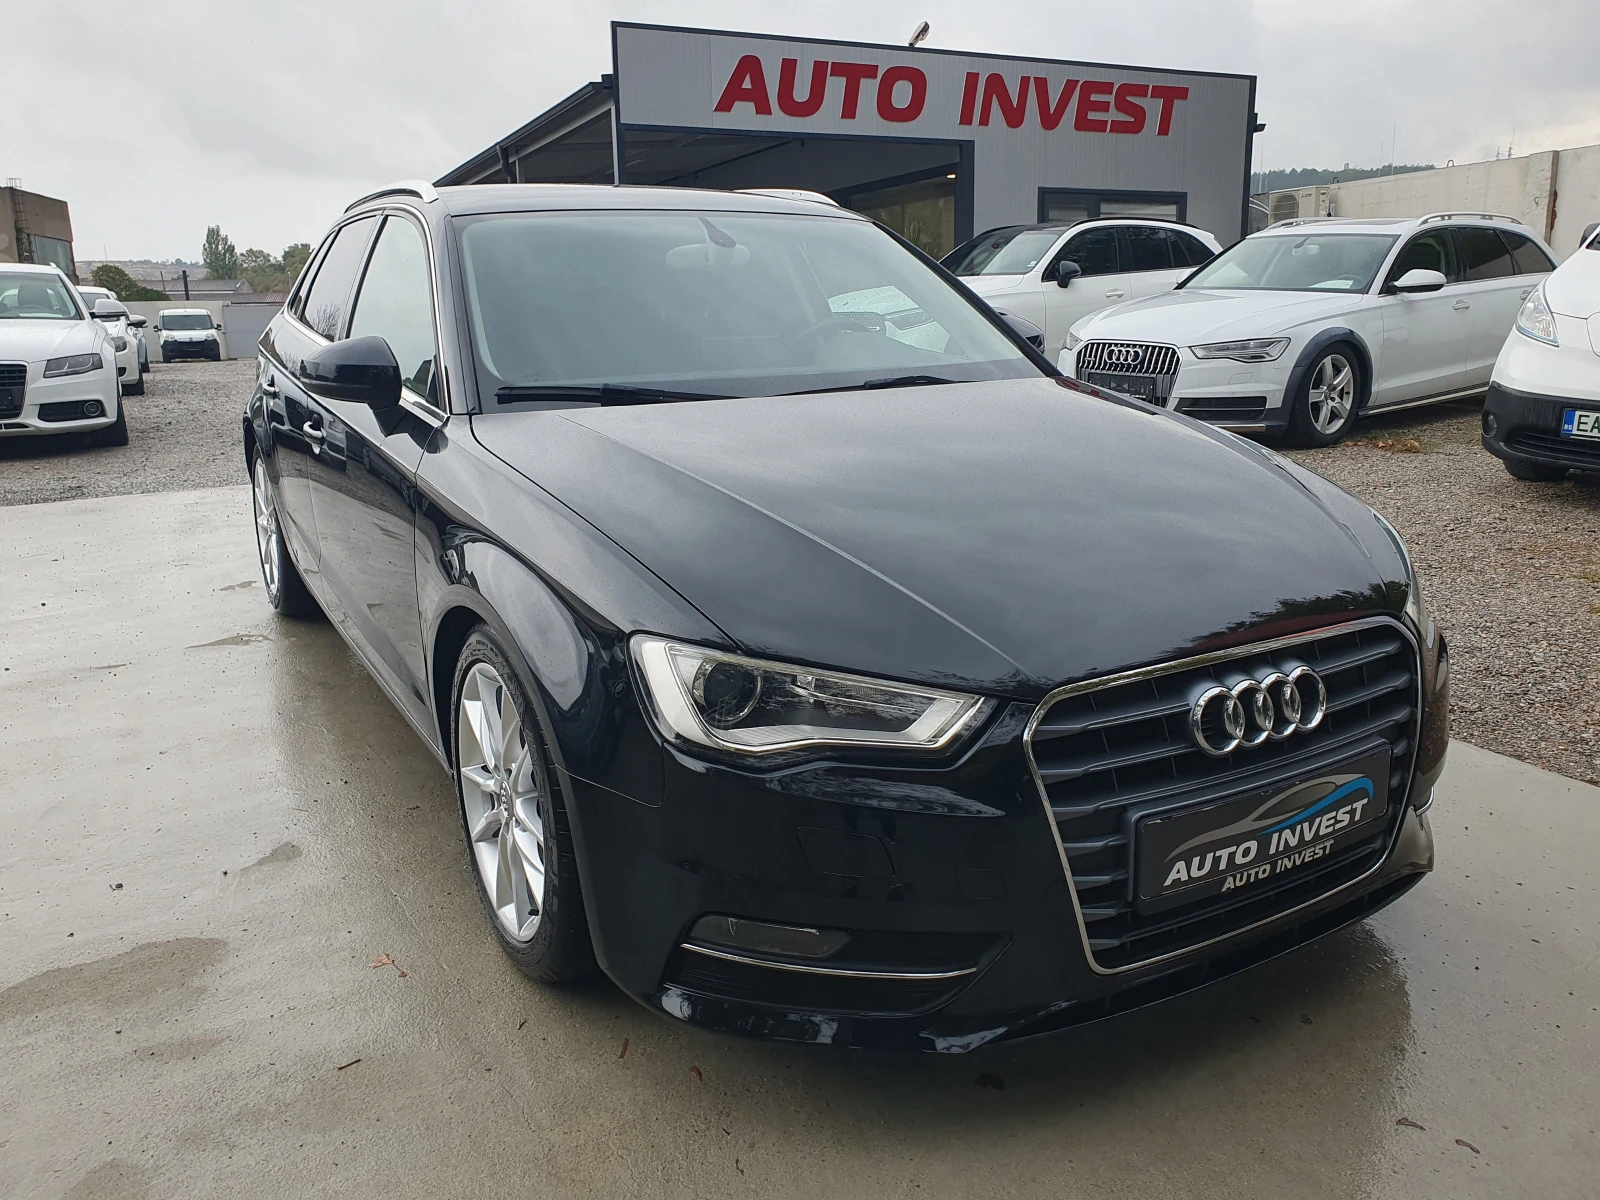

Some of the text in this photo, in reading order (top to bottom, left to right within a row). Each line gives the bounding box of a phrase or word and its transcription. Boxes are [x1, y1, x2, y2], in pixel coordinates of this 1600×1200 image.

[714, 54, 1190, 137] AUTO INVEST
[1163, 797, 1369, 887] AUTO INVEST
[1221, 839, 1335, 892] AUTO INVEST
